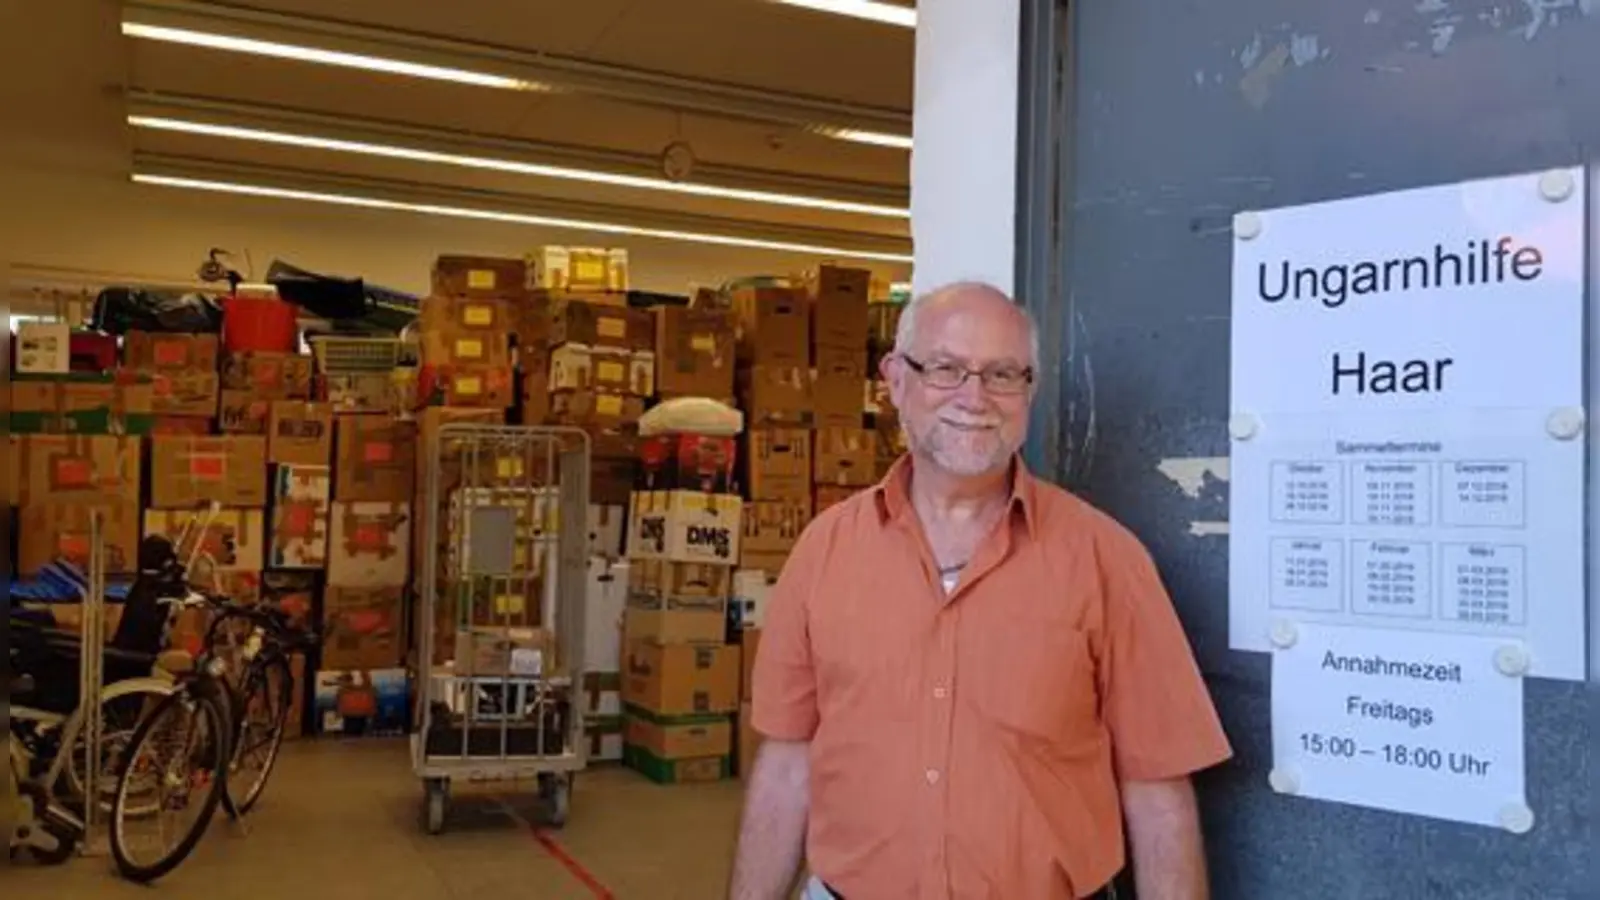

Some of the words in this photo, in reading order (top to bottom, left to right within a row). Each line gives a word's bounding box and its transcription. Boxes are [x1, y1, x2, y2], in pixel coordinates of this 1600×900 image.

[1259, 237, 1543, 308] Ungarnhilfe
[1332, 352, 1453, 394] Haar
[686, 526, 731, 546] DMS
[1321, 649, 1462, 683] Annahmezeit
[1346, 696, 1434, 728] Freitags
[1300, 733, 1356, 758] 15:00
[1382, 744, 1442, 770] 18:00
[1449, 752, 1492, 775] Uhr
